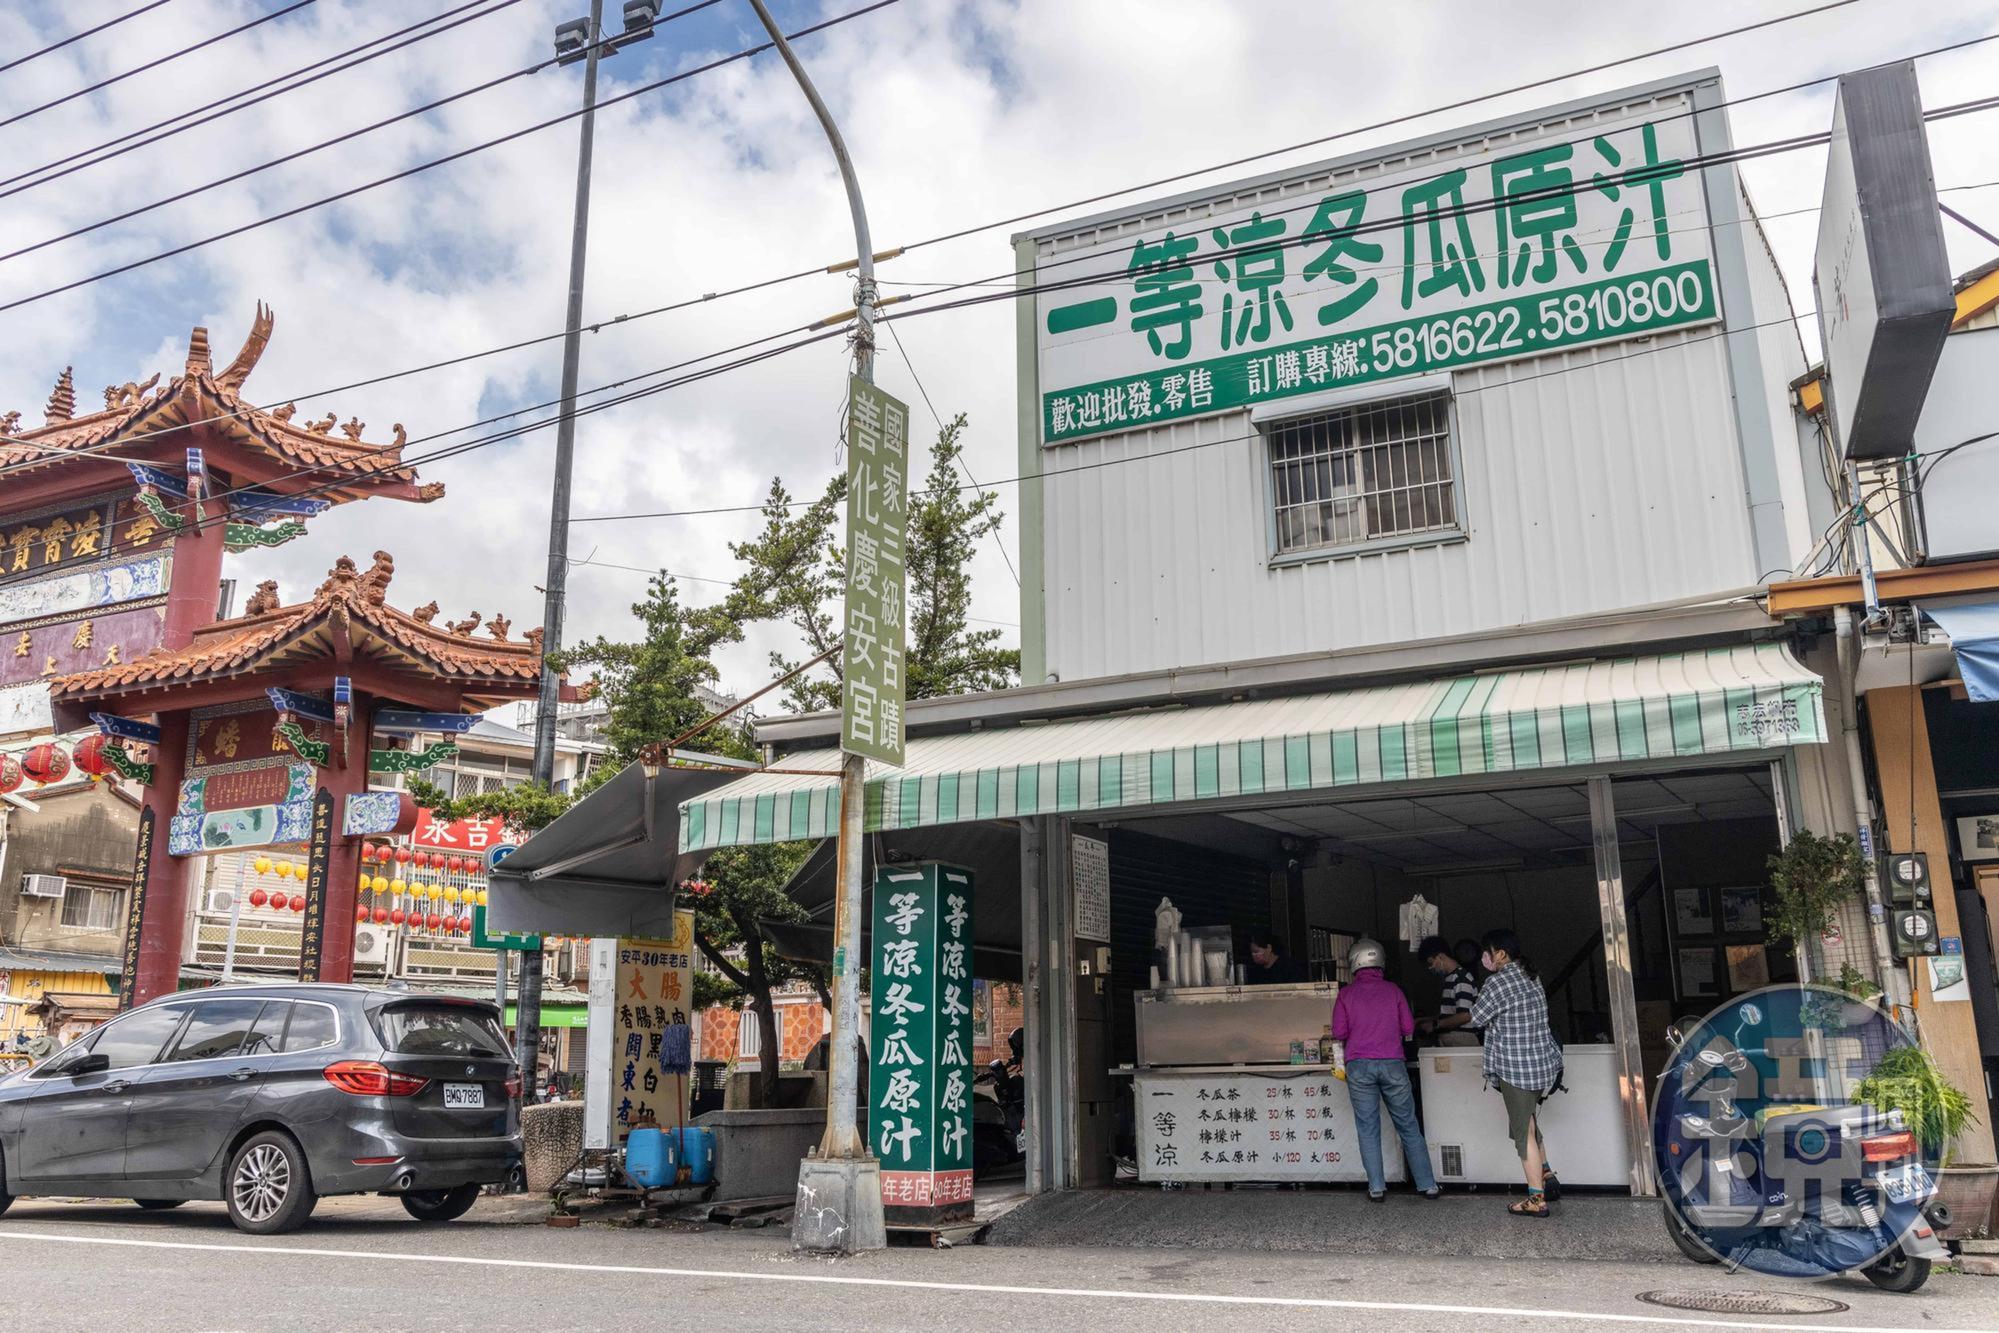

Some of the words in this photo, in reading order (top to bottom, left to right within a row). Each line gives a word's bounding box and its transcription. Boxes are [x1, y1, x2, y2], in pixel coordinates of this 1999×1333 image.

[1047, 121, 1685, 360] 一等涼冬瓜原汁
[1051, 367, 1214, 435] 歡迎批發.零售
[849, 389, 881, 747] 善化慶安宮
[880, 401, 904, 755] 國家三級古蹟
[620, 949, 689, 968] 安平30年老店
[628, 967, 682, 1001] 大腸
[878, 871, 926, 1163] 一等涼冬瓜原汁
[940, 871, 970, 1162] 一等涼冬瓜原汁
[1196, 1088, 1241, 1101] 冬瓜茶
[1198, 1107, 1258, 1123] 冬瓜檸檬
[1151, 1091, 1179, 1167] 一等涼
[1199, 1129, 1242, 1144] 檸檬汁
[1200, 1150, 1260, 1164] 冬瓜原汁
[881, 1175, 930, 1202] 年老店
